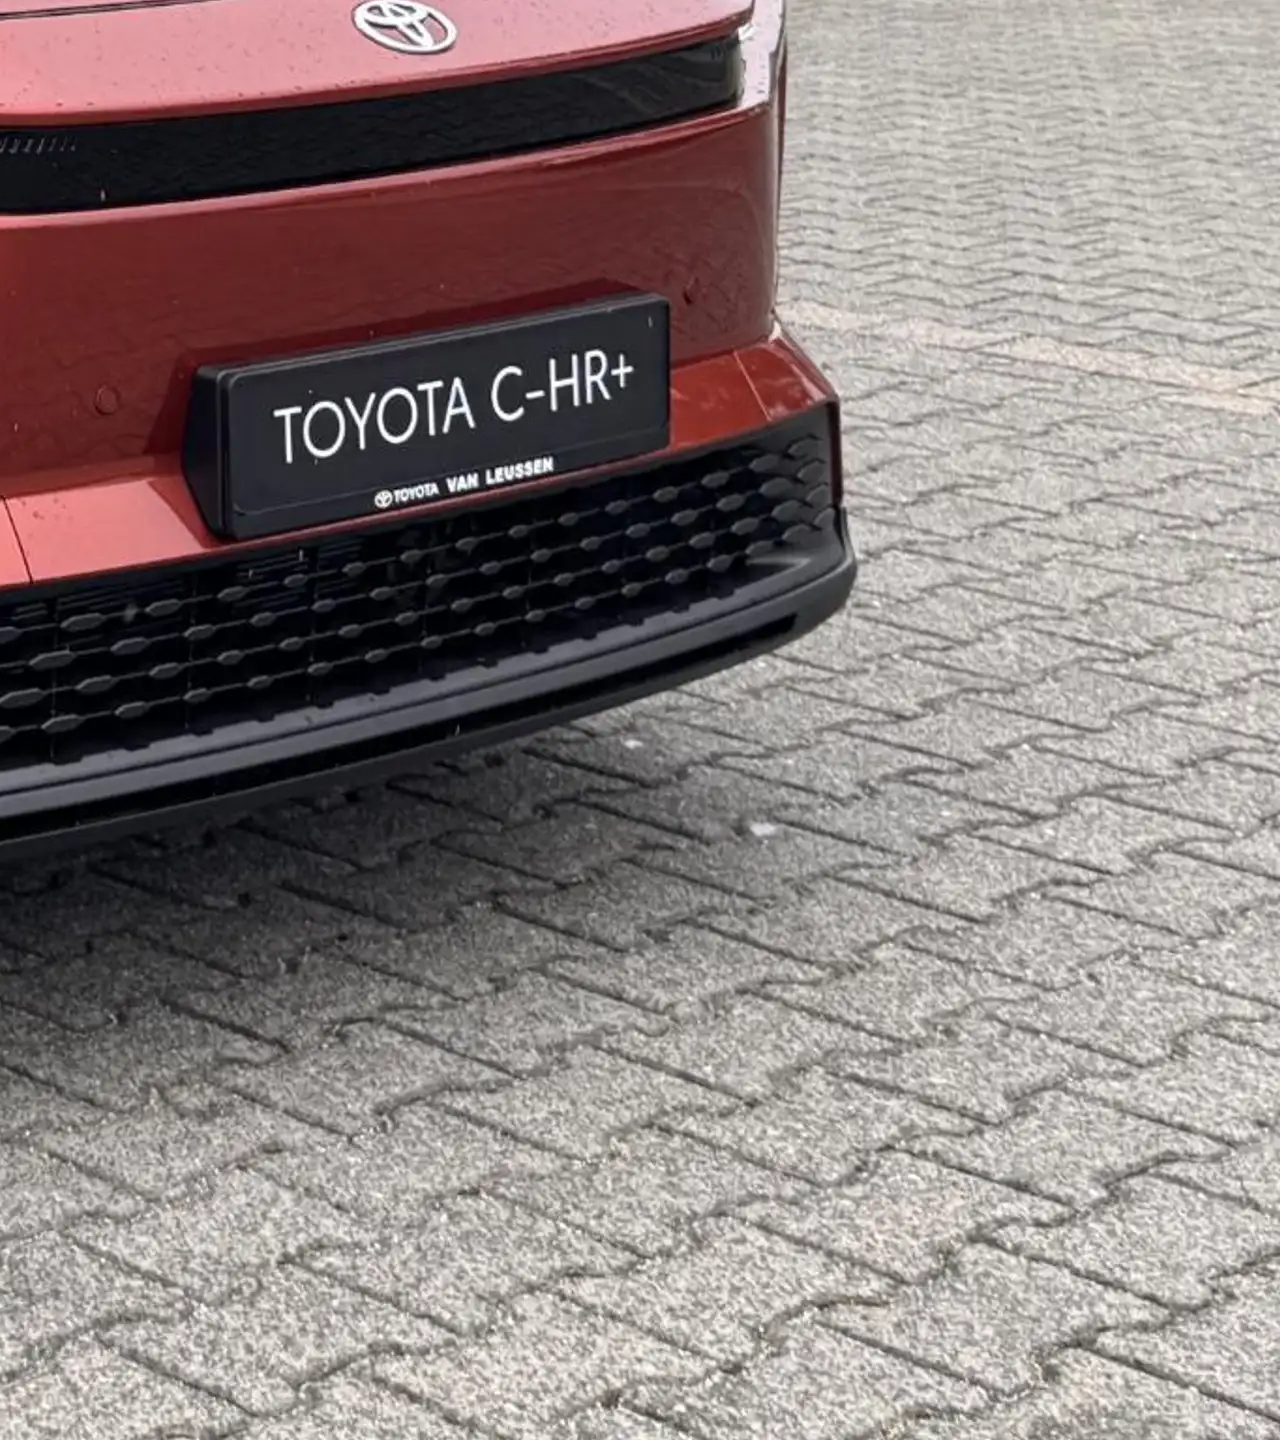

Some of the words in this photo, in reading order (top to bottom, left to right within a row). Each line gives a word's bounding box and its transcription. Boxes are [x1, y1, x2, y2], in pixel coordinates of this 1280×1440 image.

[273, 376, 477, 464] TOYOTA
[491, 348, 635, 422] C-HR+
[393, 481, 440, 503] TOYOTA
[445, 471, 480, 494] VAN
[484, 456, 555, 486] LEUSSEN
